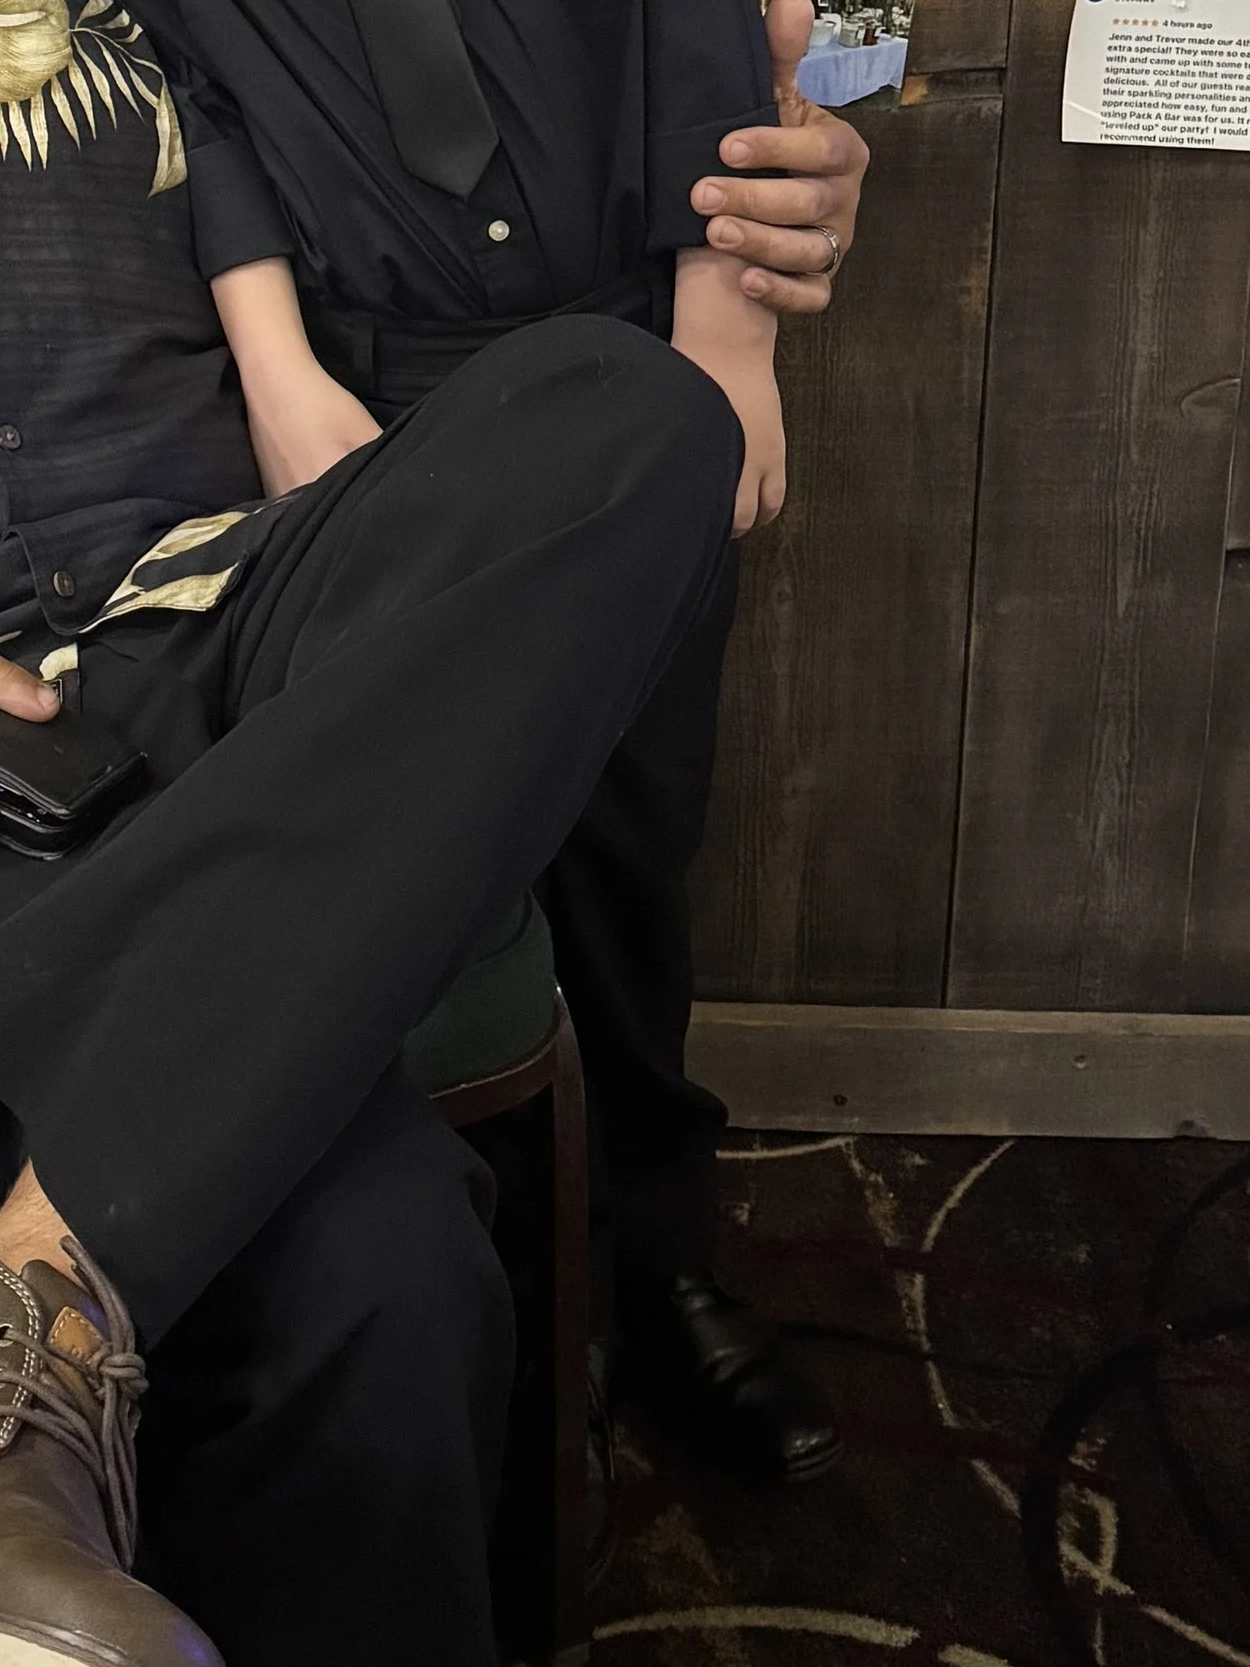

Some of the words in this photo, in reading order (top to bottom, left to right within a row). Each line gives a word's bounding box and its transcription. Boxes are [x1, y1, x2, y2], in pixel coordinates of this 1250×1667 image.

[1170, 20, 1194, 28] hours
[1197, 22, 1213, 30] ago
[1109, 33, 1132, 41] Jenn
[1135, 34, 1152, 42] and
[1156, 35, 1186, 43] Trevor
[1134, 46, 1172, 55] special!
[1175, 47, 1198, 57] They
[1150, 58, 1175, 66] came
[1178, 60, 1190, 69] up
[1216, 61, 1242, 69] some
[1105, 66, 1150, 75] signature
[1153, 68, 1195, 77] cocktails
[1199, 71, 1218, 79] that
[1221, 72, 1244, 80] were
[1104, 77, 1149, 87] delicious.
[1154, 79, 1167, 87] All
[1170, 80, 1179, 88] of
[1200, 83, 1233, 91] guests
[1103, 88, 1125, 96] their
[1127, 90, 1172, 100] sparkling
[1174, 91, 1237, 101] personalities
[1102, 100, 1159, 110] appreciated
[1161, 102, 1182, 110] how
[1184, 104, 1208, 113] easy,
[1211, 104, 1227, 112] fun
[1229, 105, 1247, 113] and
[1101, 111, 1127, 120] using
[1129, 112, 1152, 120] Pack
[1164, 113, 1180, 121] Bar
[1204, 115, 1219, 123] for
[1221, 116, 1234, 124] us.
[1100, 134, 1156, 142] recommend
[1159, 136, 1184, 145] using
[1187, 137, 1215, 145] them!
